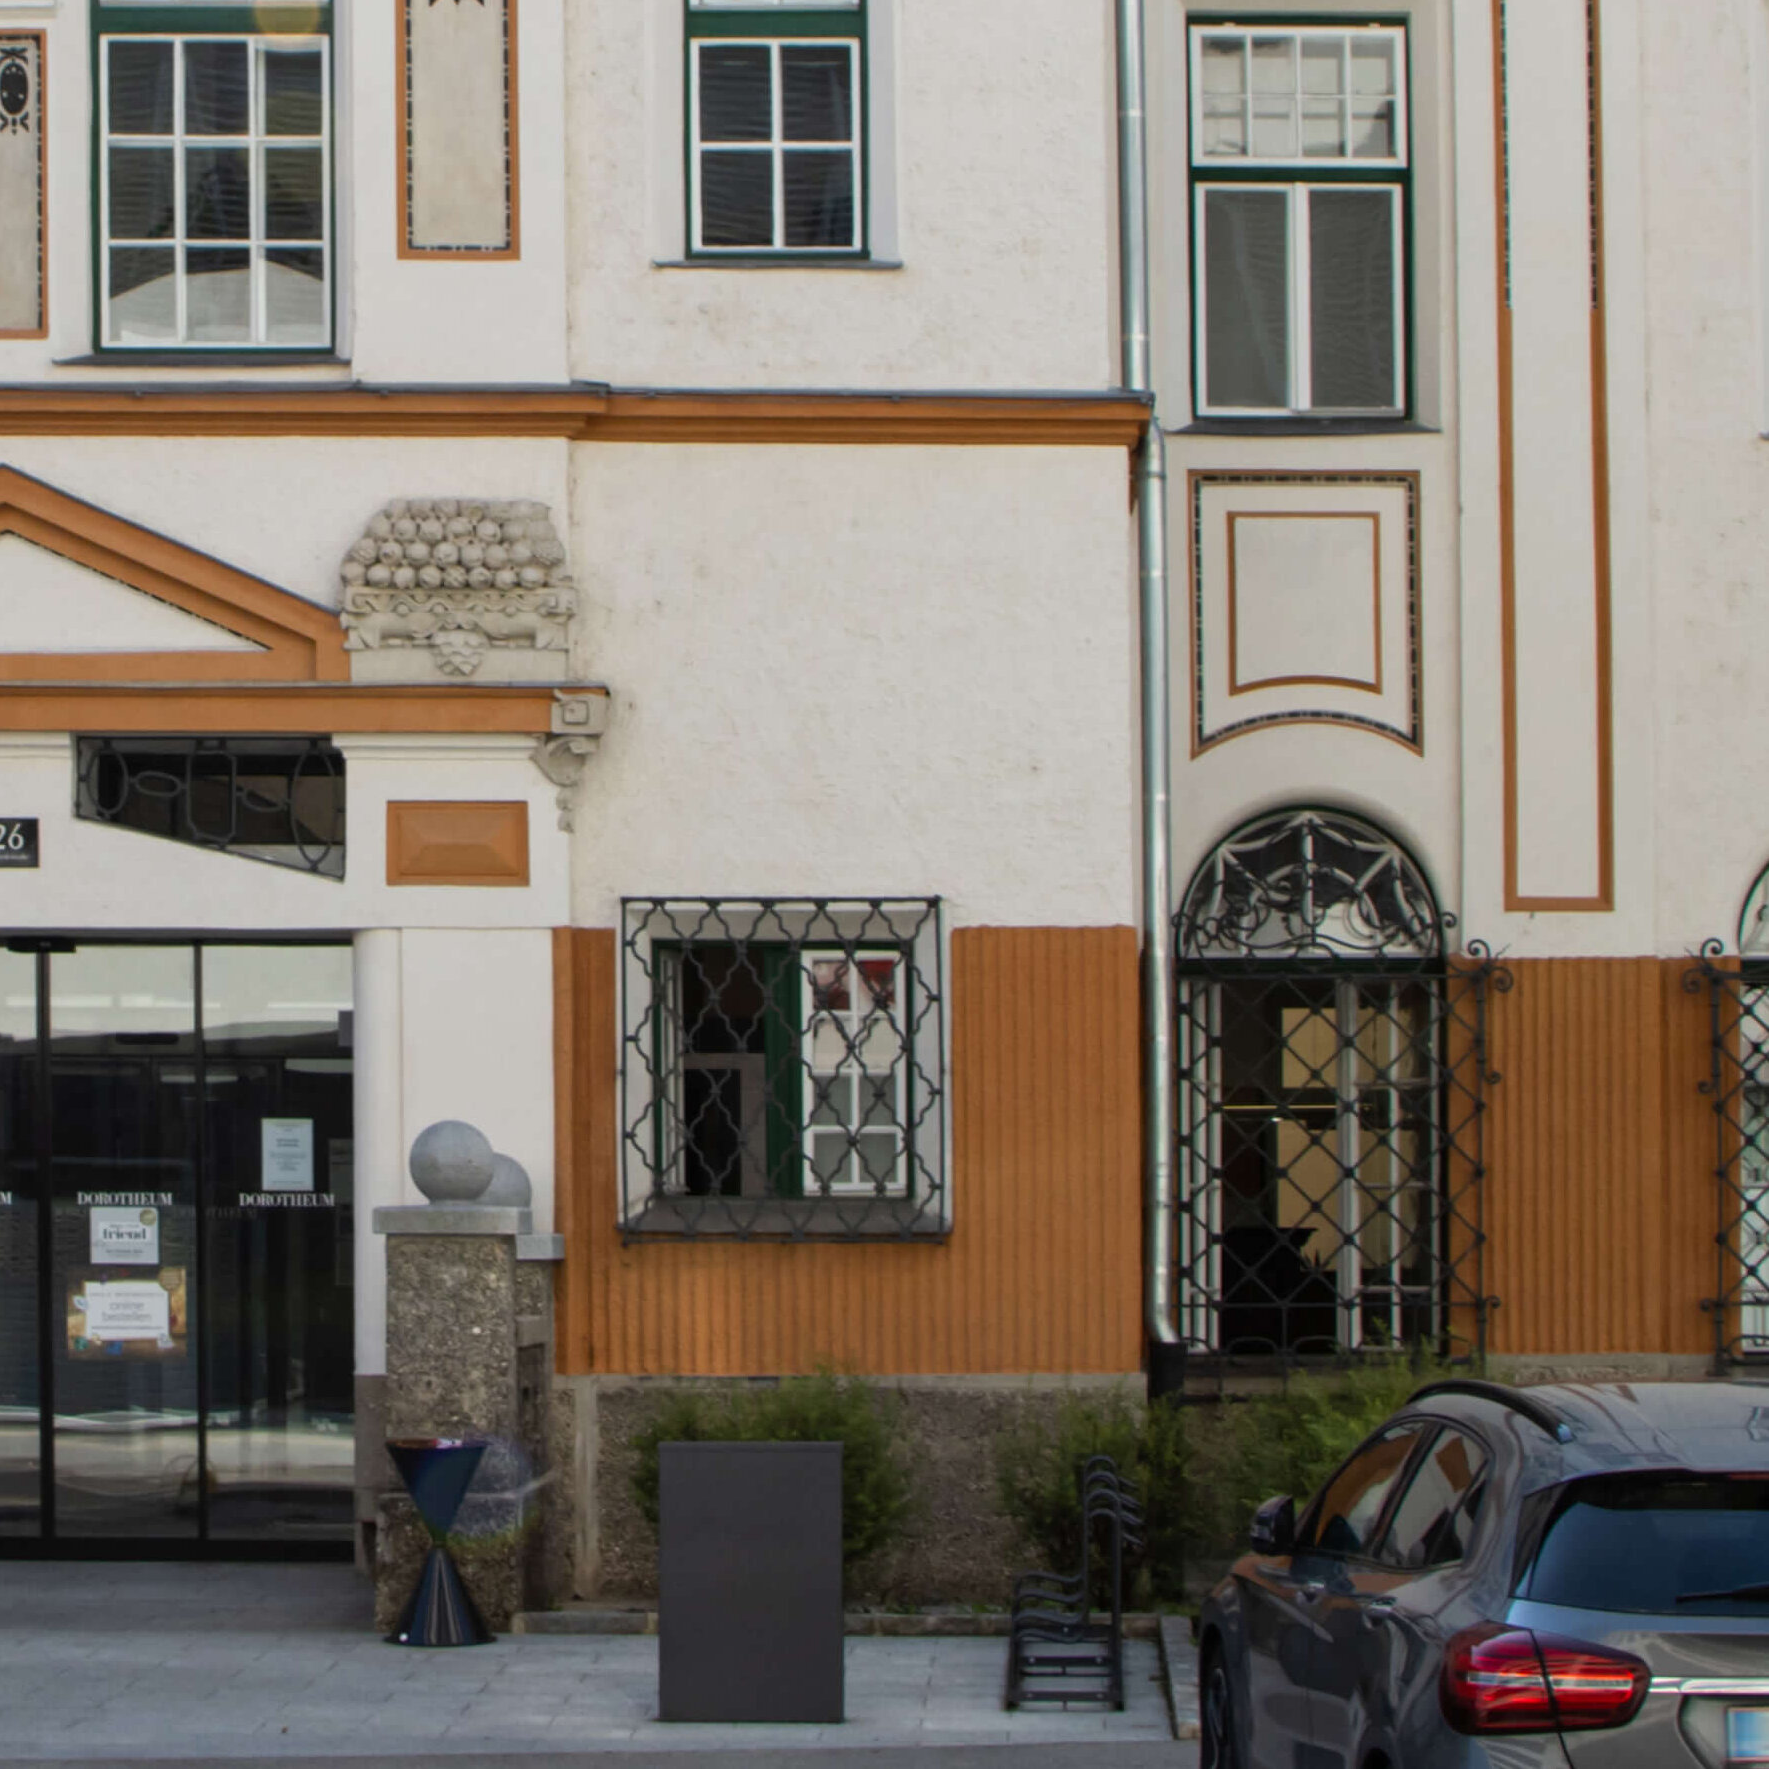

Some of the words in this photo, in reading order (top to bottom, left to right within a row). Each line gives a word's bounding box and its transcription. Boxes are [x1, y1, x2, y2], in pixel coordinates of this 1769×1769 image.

[77, 1191, 173, 1206] DOROTHEUM
[239, 1193, 335, 1207] DOROTHEUM
[103, 1228, 147, 1240] friend
